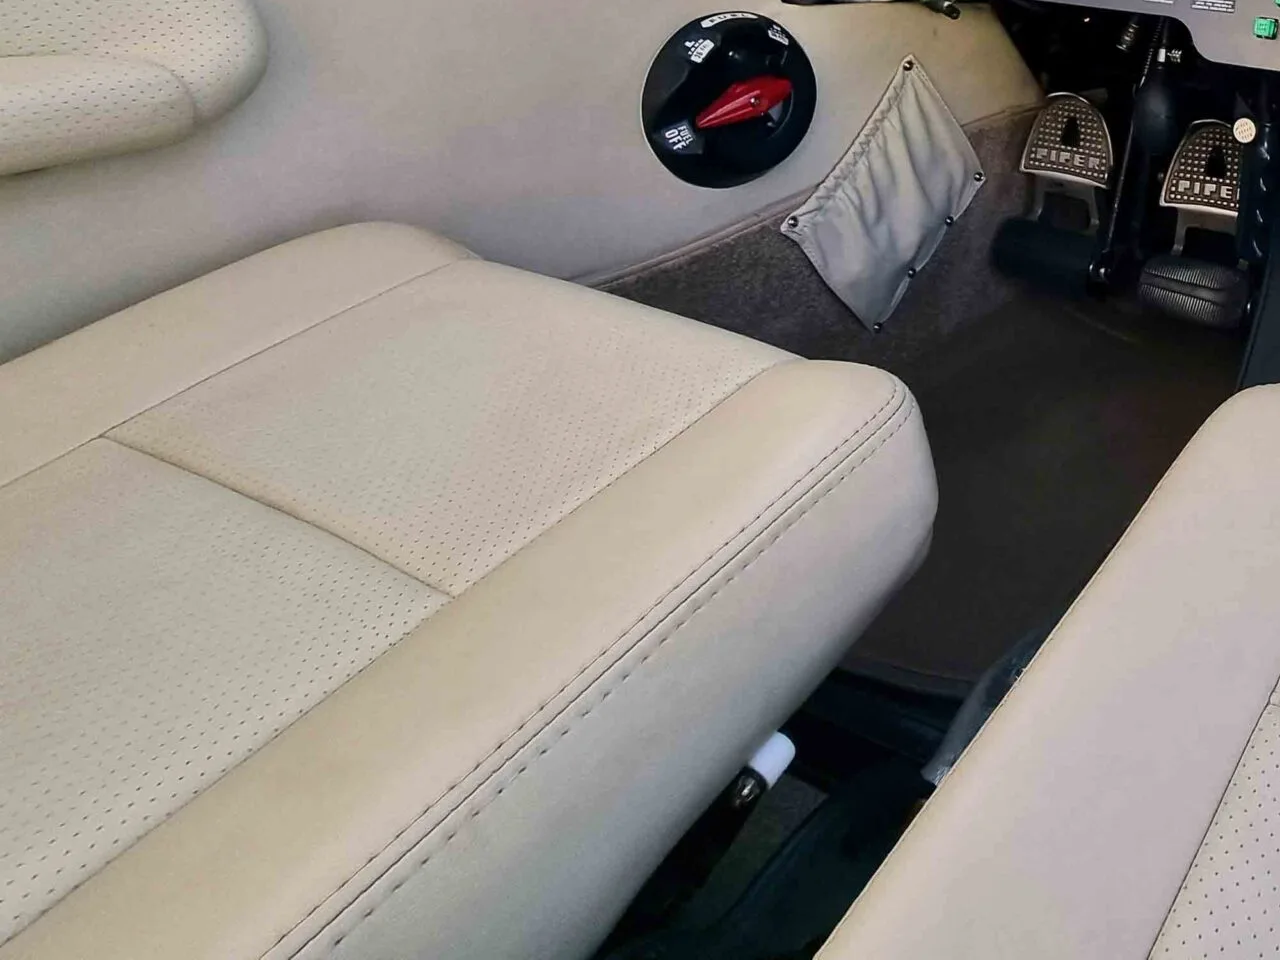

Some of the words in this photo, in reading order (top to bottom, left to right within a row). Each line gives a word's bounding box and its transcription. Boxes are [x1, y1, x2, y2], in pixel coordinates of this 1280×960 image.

[664, 128, 687, 151] OFF
[677, 125, 694, 145] FUEL
[1035, 147, 1101, 170] PIPER
